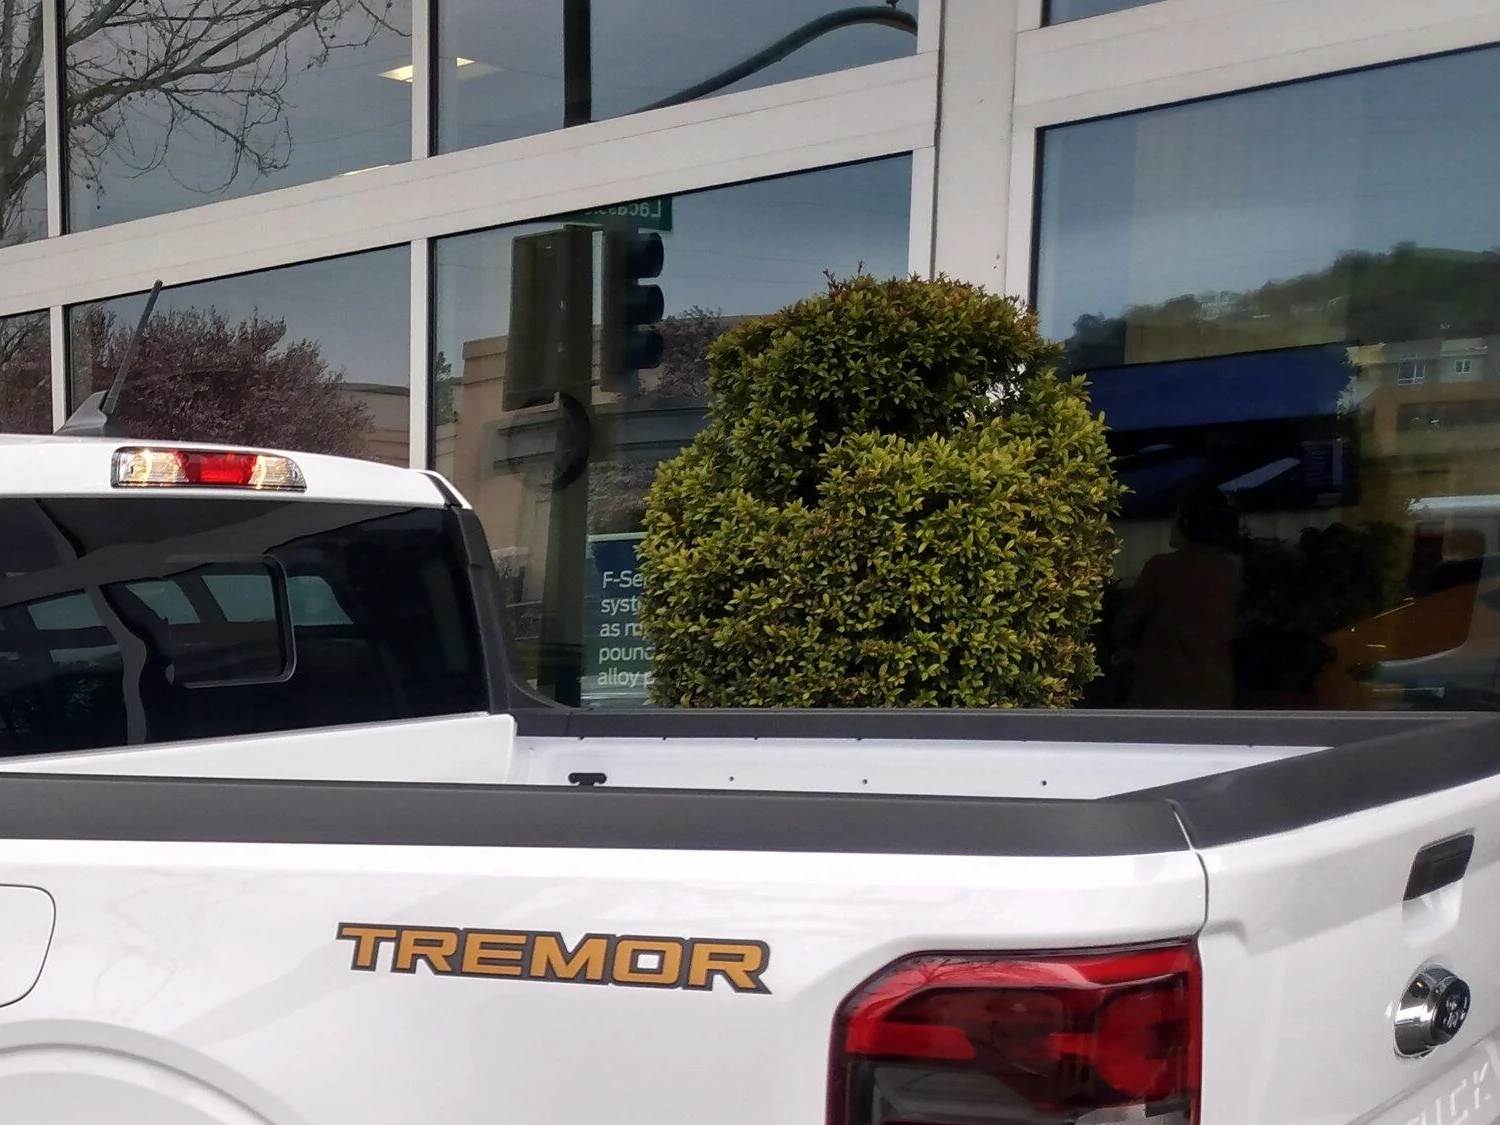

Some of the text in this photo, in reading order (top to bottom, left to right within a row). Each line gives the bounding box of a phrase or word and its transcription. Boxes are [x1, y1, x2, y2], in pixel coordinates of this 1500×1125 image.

[600, 623, 620, 637] as
[597, 668, 640, 688] alloy
[336, 922, 772, 994] TREMOR
